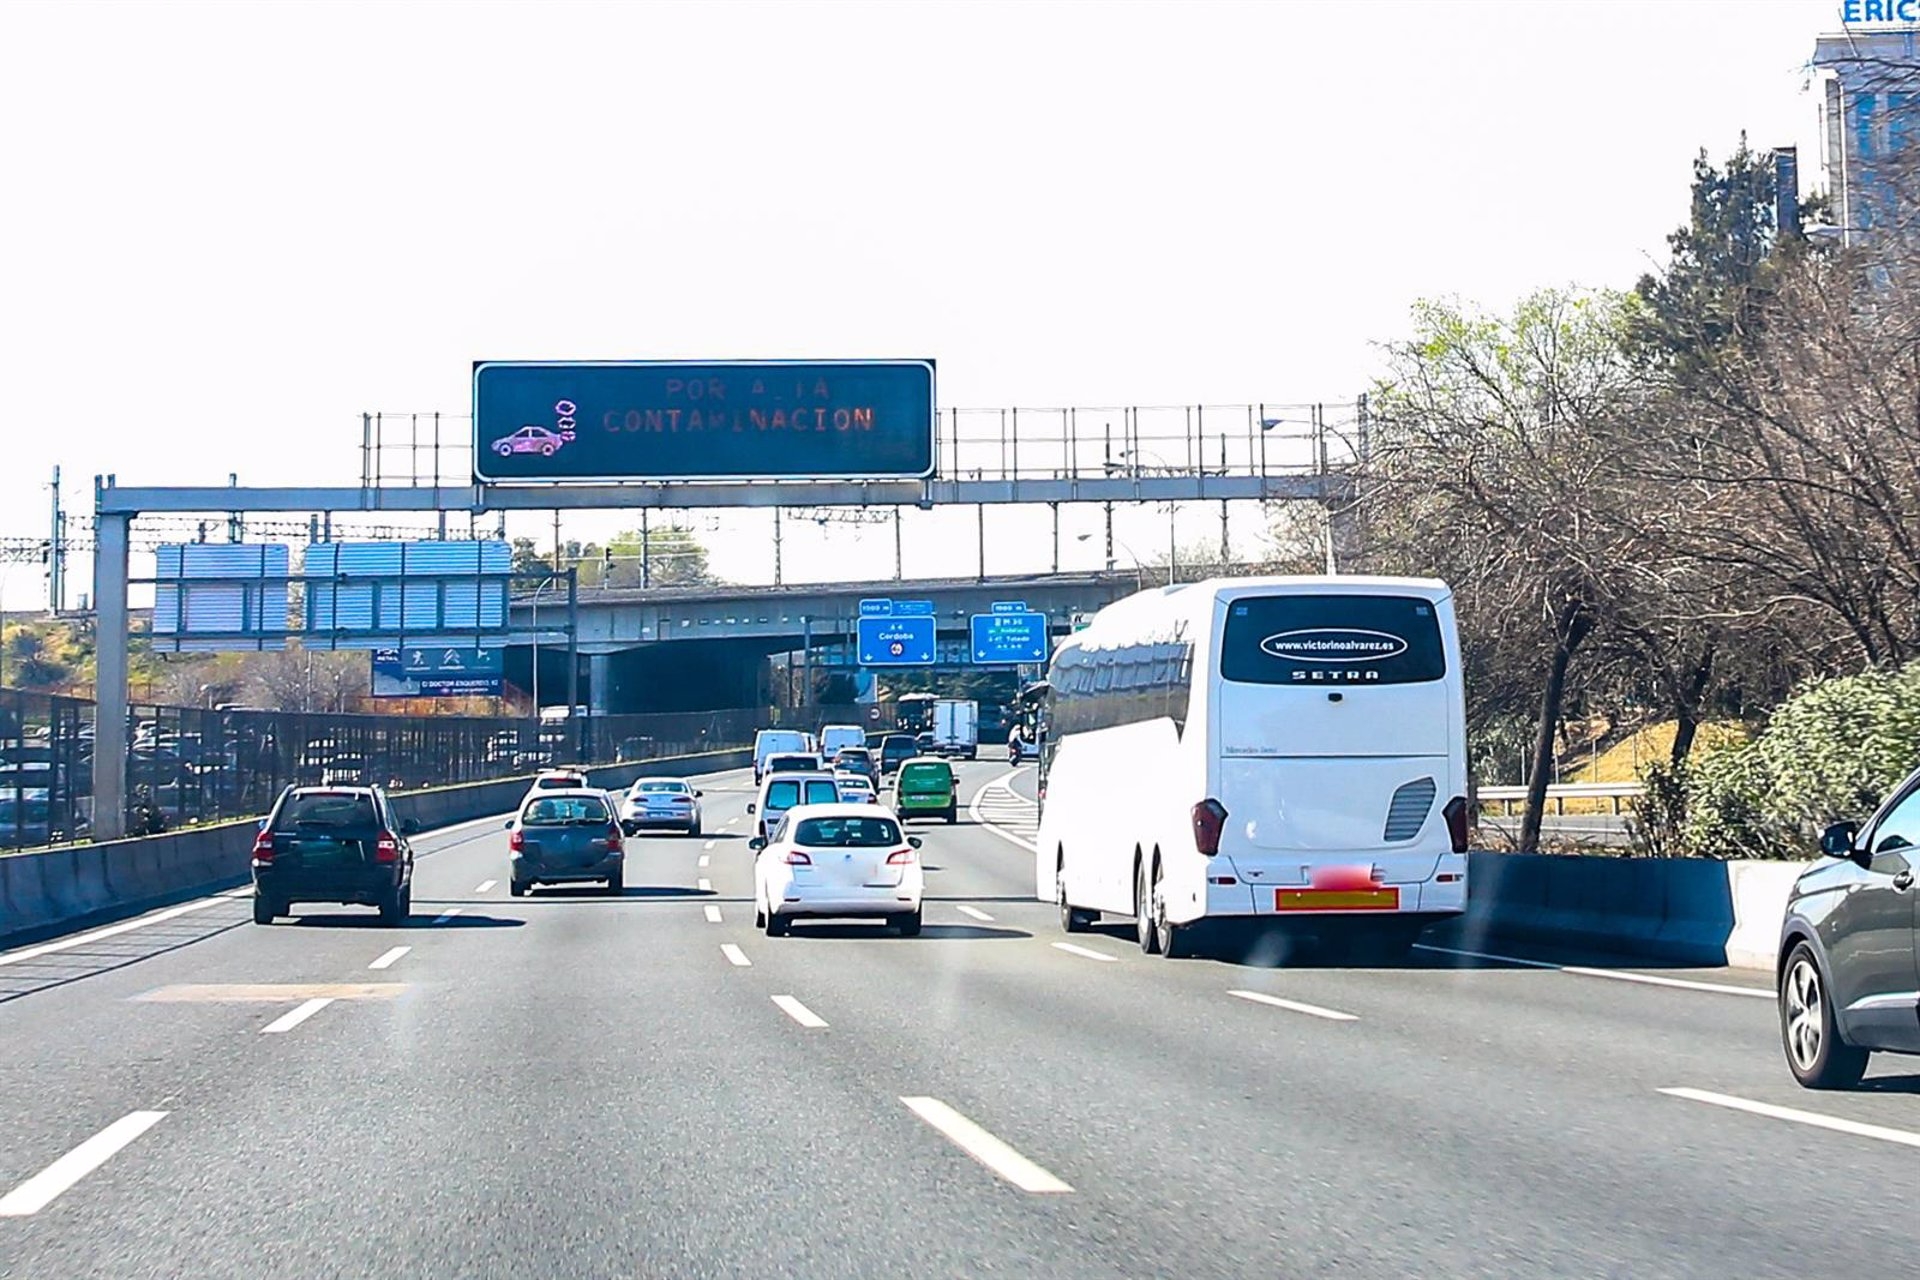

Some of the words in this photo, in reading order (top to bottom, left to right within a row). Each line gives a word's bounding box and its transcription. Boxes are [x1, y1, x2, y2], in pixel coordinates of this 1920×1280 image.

[1843, 0, 1920, 22] ERIC
[602, 407, 873, 433] CONTAMINACION
[1275, 640, 1394, 651] www.victorinoalvarez.es
[1291, 670, 1380, 680] SETRA
